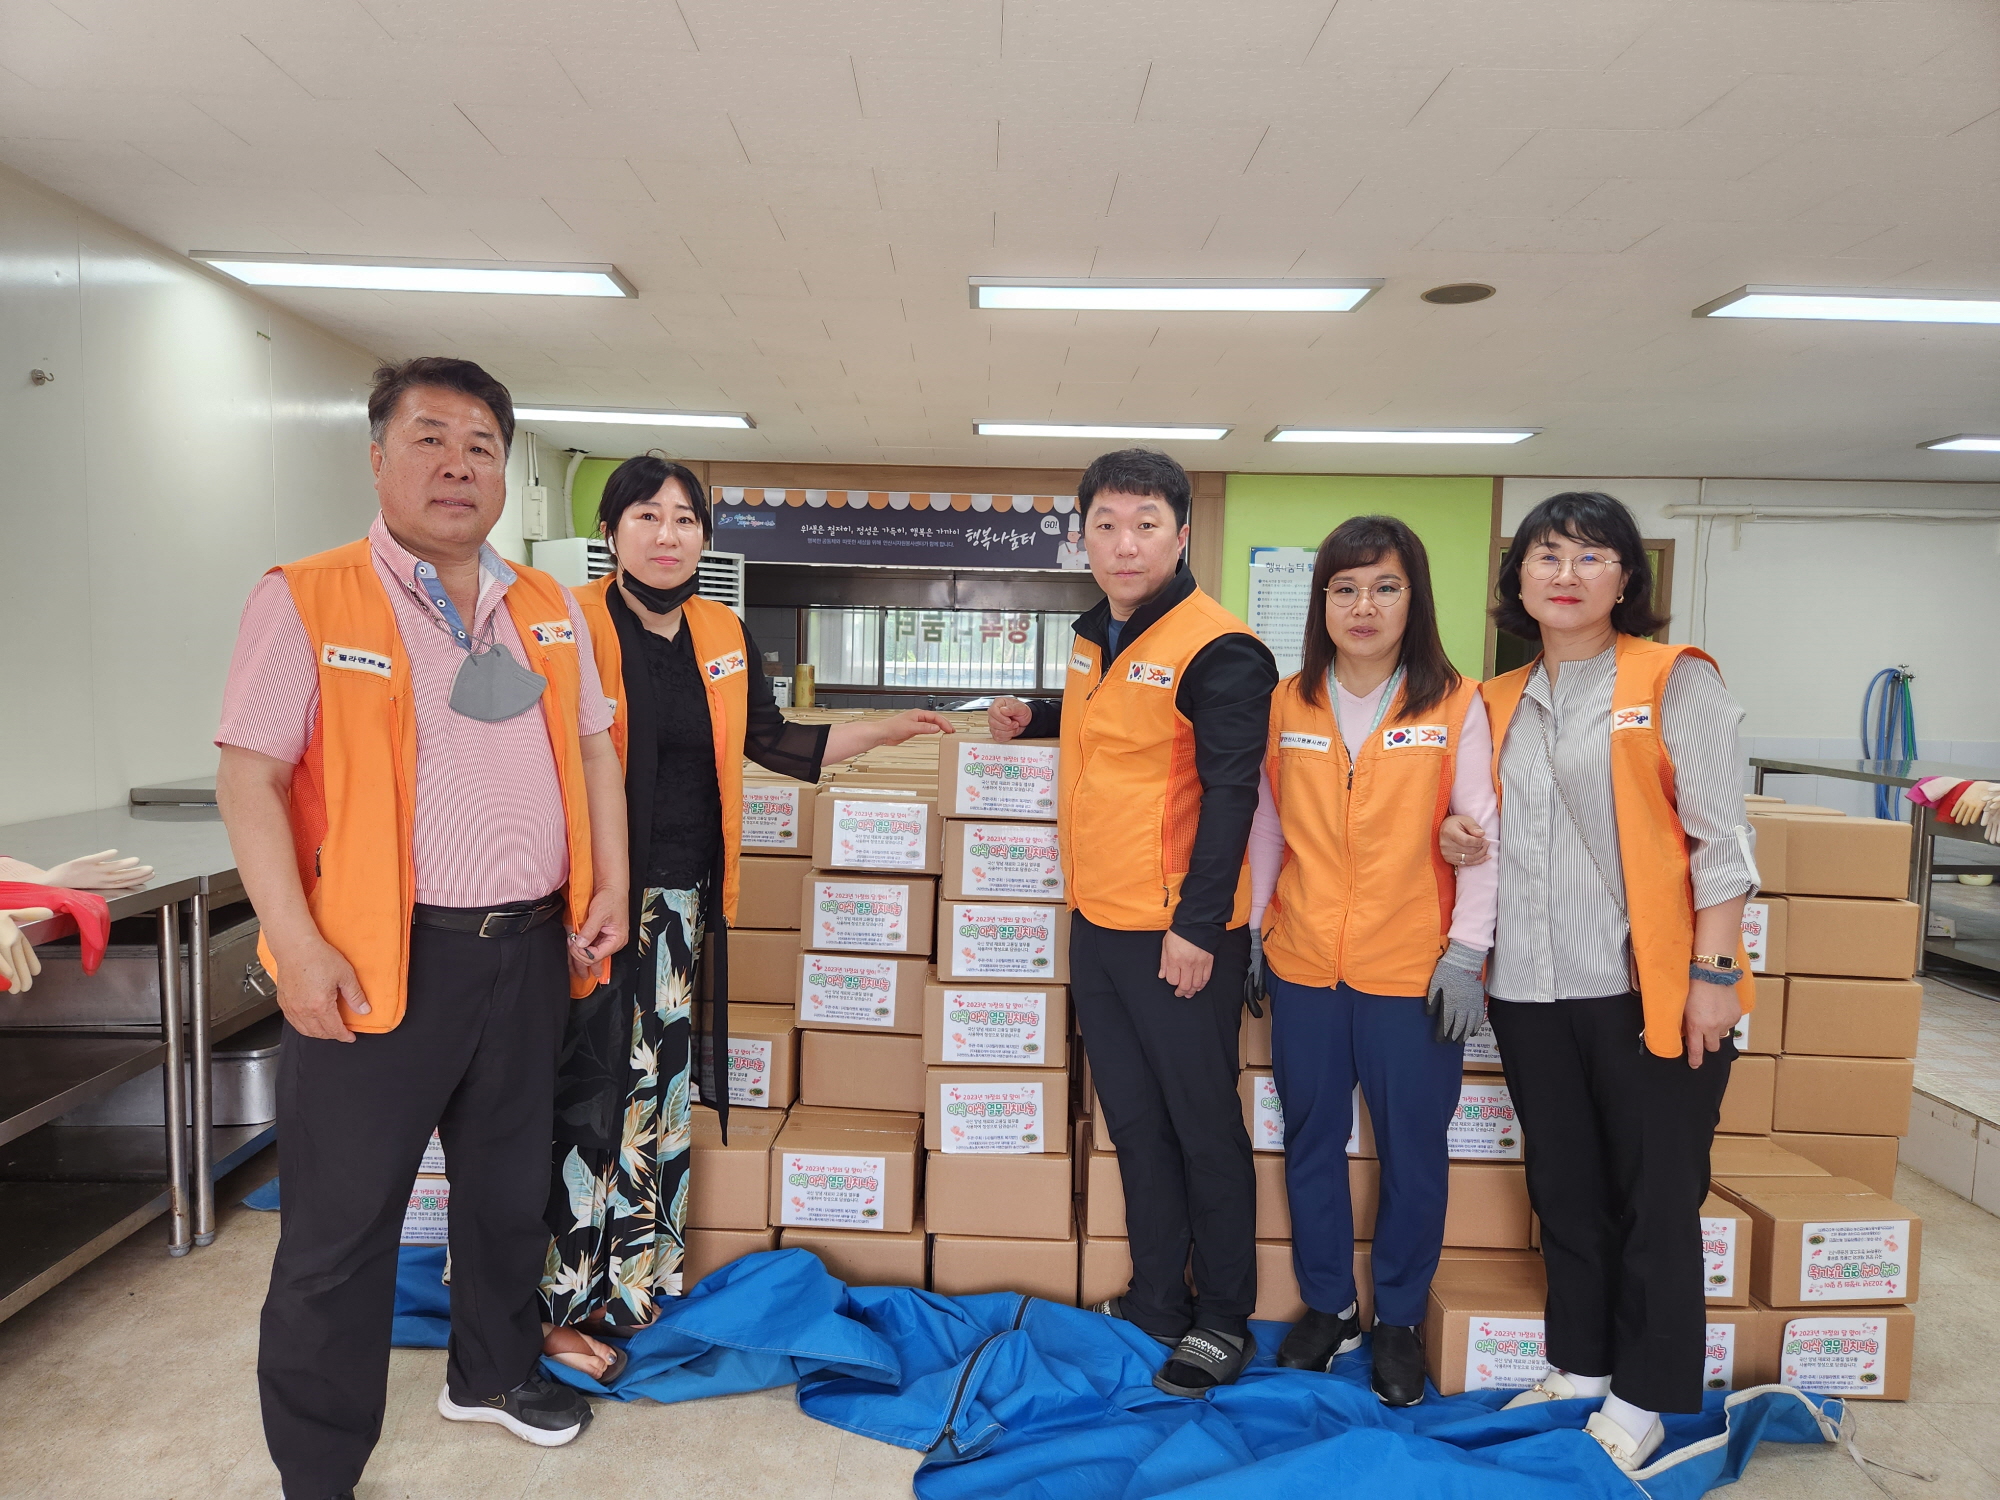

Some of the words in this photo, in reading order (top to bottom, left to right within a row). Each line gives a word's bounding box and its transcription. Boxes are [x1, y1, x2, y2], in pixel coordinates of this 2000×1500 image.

[800, 525, 824, 535] 위생은
[827, 525, 854, 536] 철저히,
[856, 526, 879, 536] 정성은
[882, 527, 907, 537] 가득히,
[910, 527, 933, 537] 행복은
[936, 528, 960, 536] 가까이
[1044, 521, 1058, 529] GO!
[965, 527, 1036, 551] 행복나눔터
[964, 761, 984, 776] 아삭
[983, 762, 1002, 777] 아삭
[1003, 763, 1053, 780] 열무김치나눔
[750, 802, 793, 816] 열무김치나눔
[970, 843, 989, 858] 아삭
[989, 844, 1008, 858] 아삭
[1008, 844, 1058, 860] 열무김치나눔
[959, 924, 978, 938] 아삭
[979, 924, 997, 938] 아삭
[998, 924, 1048, 939] 열무김치나눔
[808, 972, 826, 986] 아삭
[826, 973, 844, 987] 아삭
[844, 974, 890, 991] 열무김치나눔
[950, 1009, 969, 1023] 아삭
[969, 1009, 988, 1024] 아삭
[988, 1010, 1038, 1025] 열무김치나눔
[728, 1056, 765, 1072] 무김치나눔
[947, 1102, 966, 1116] 아삭
[966, 1102, 985, 1116] 아삭
[986, 1101, 1036, 1116] 열무김치나눔
[1463, 1104, 1514, 1120] 열무김치나눔
[789, 1172, 808, 1187] 아삭
[808, 1173, 827, 1188] 아삭
[827, 1174, 877, 1190] 열무김치나눔
[1475, 1339, 1497, 1355] 아삭
[1497, 1339, 1518, 1356] 아삭
[1802, 1338, 1821, 1354] 아삭
[1822, 1338, 1879, 1355] 열무김치나눔
